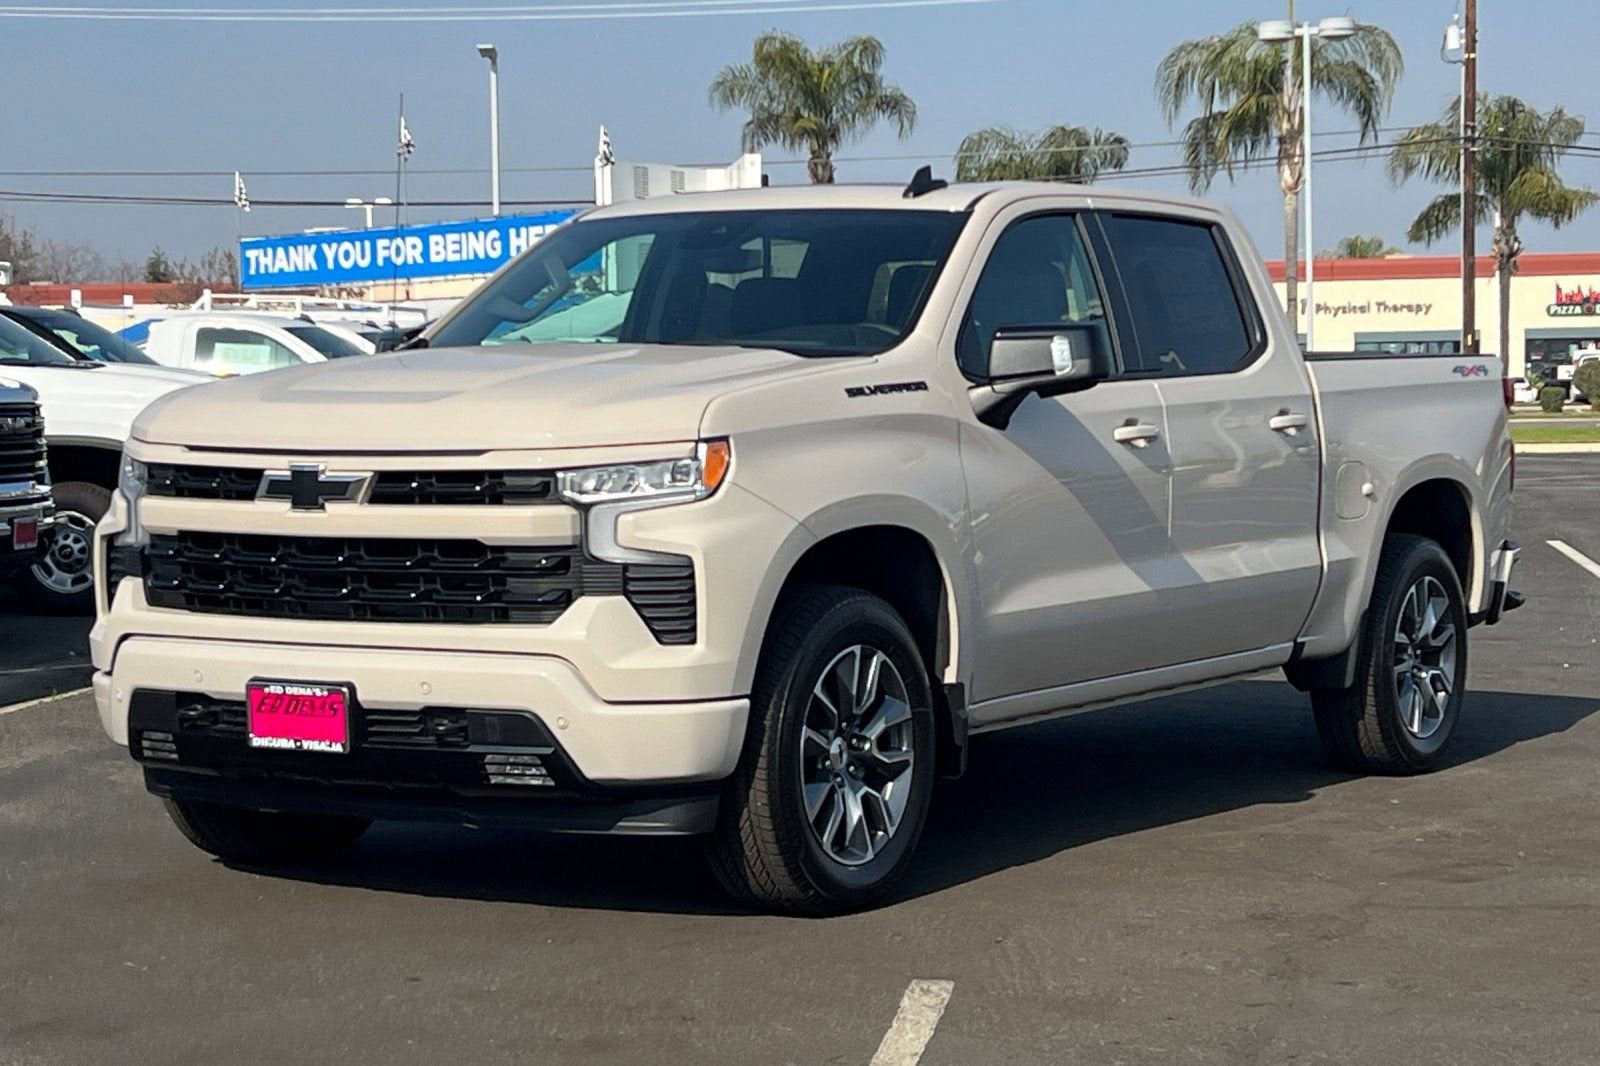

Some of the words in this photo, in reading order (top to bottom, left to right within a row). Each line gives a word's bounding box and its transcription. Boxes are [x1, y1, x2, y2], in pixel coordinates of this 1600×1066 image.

[245, 244, 318, 275] THANK
[322, 239, 371, 269] YOU
[376, 235, 425, 265] FOR
[429, 231, 501, 262] BEING
[1315, 301, 1371, 318] Physical
[1375, 300, 1433, 316] Therapy
[1550, 303, 1582, 315] PIZZA
[269, 685, 284, 695] ED
